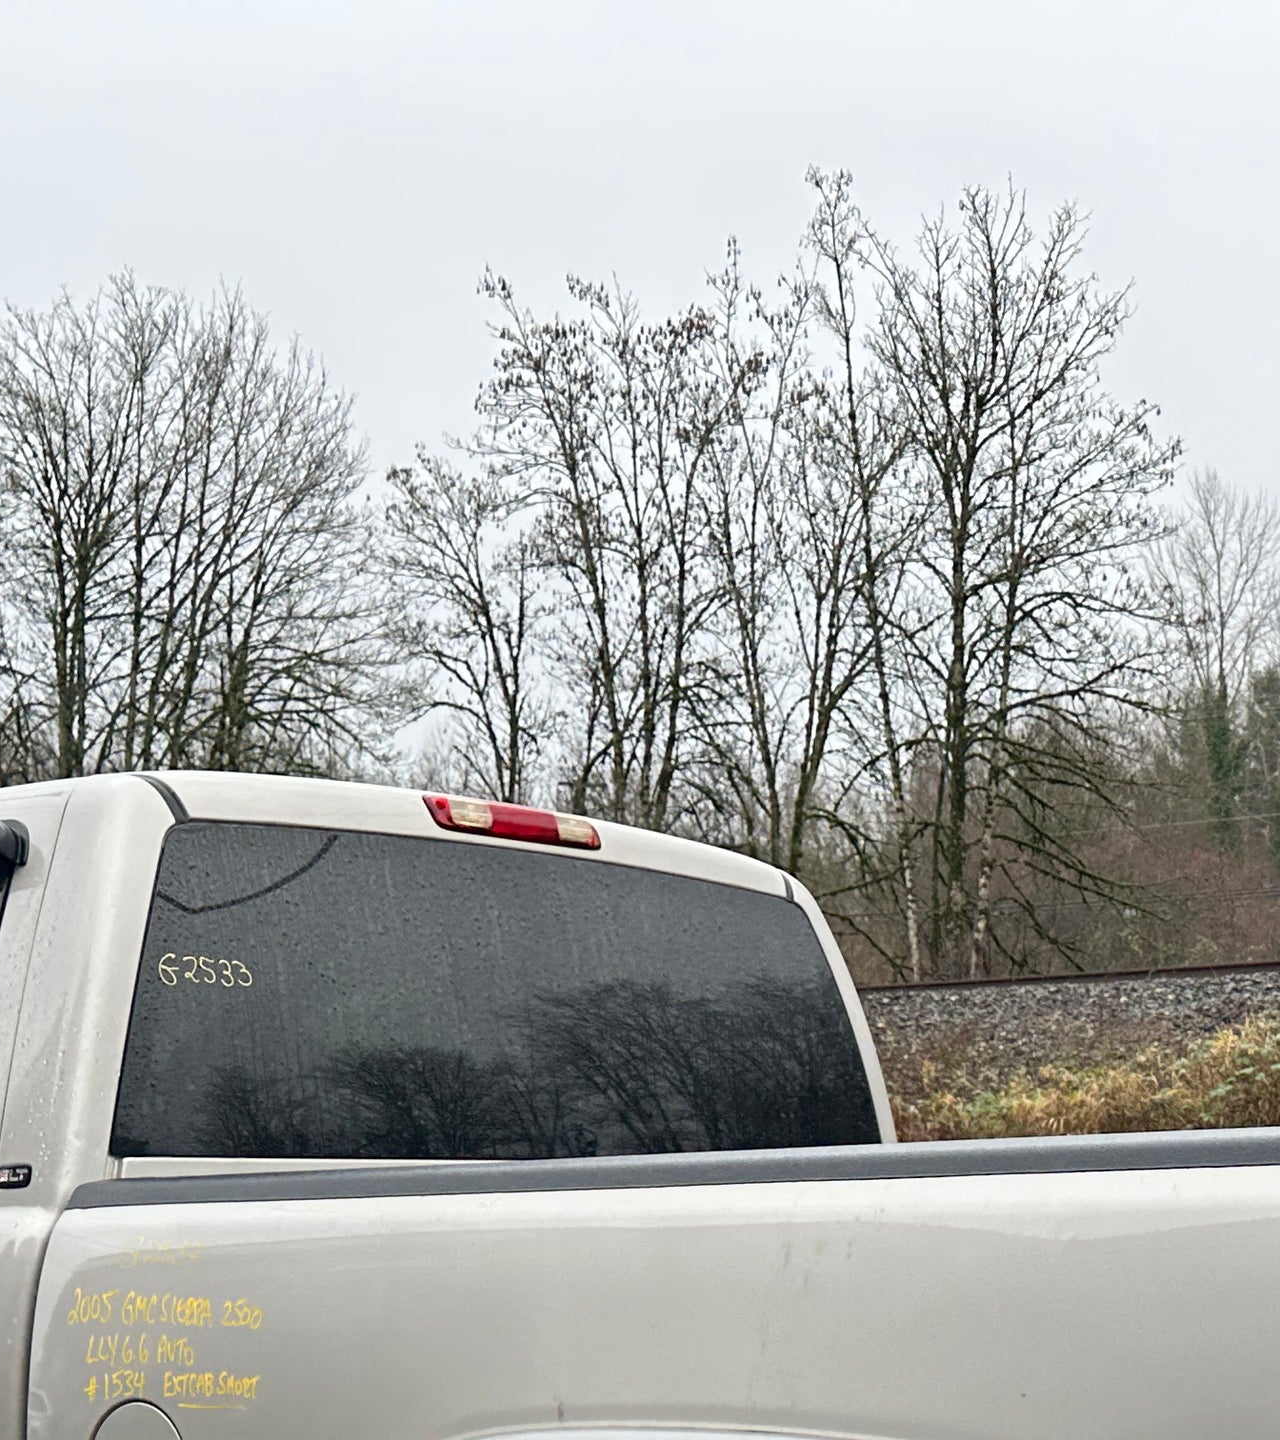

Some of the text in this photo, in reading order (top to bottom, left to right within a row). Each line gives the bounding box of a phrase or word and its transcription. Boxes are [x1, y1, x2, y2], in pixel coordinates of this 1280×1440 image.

[158, 952, 253, 987] G2533
[67, 1287, 118, 1326] 2005
[121, 1289, 157, 1326] GMC
[221, 1297, 262, 1330] 2500
[157, 1334, 194, 1367] AUTO
